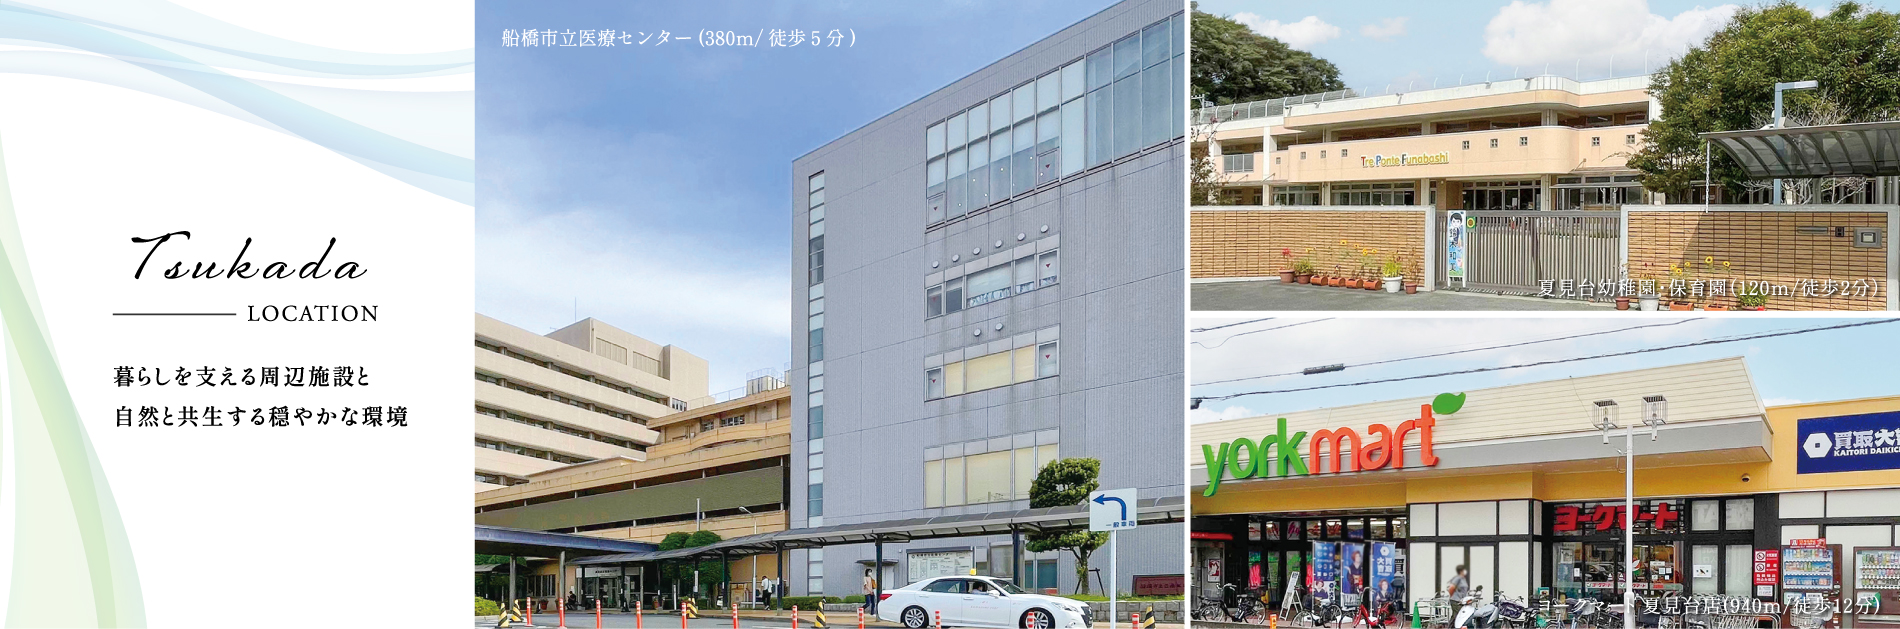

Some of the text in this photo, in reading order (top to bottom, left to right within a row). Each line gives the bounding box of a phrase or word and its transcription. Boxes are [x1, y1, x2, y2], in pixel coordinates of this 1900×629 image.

[1360, 151, 1449, 167] Tre Ponte Funabashi
[1833, 446, 1900, 457] KAITORI DAIKIC
[1553, 502, 1679, 532] ヨークマート
